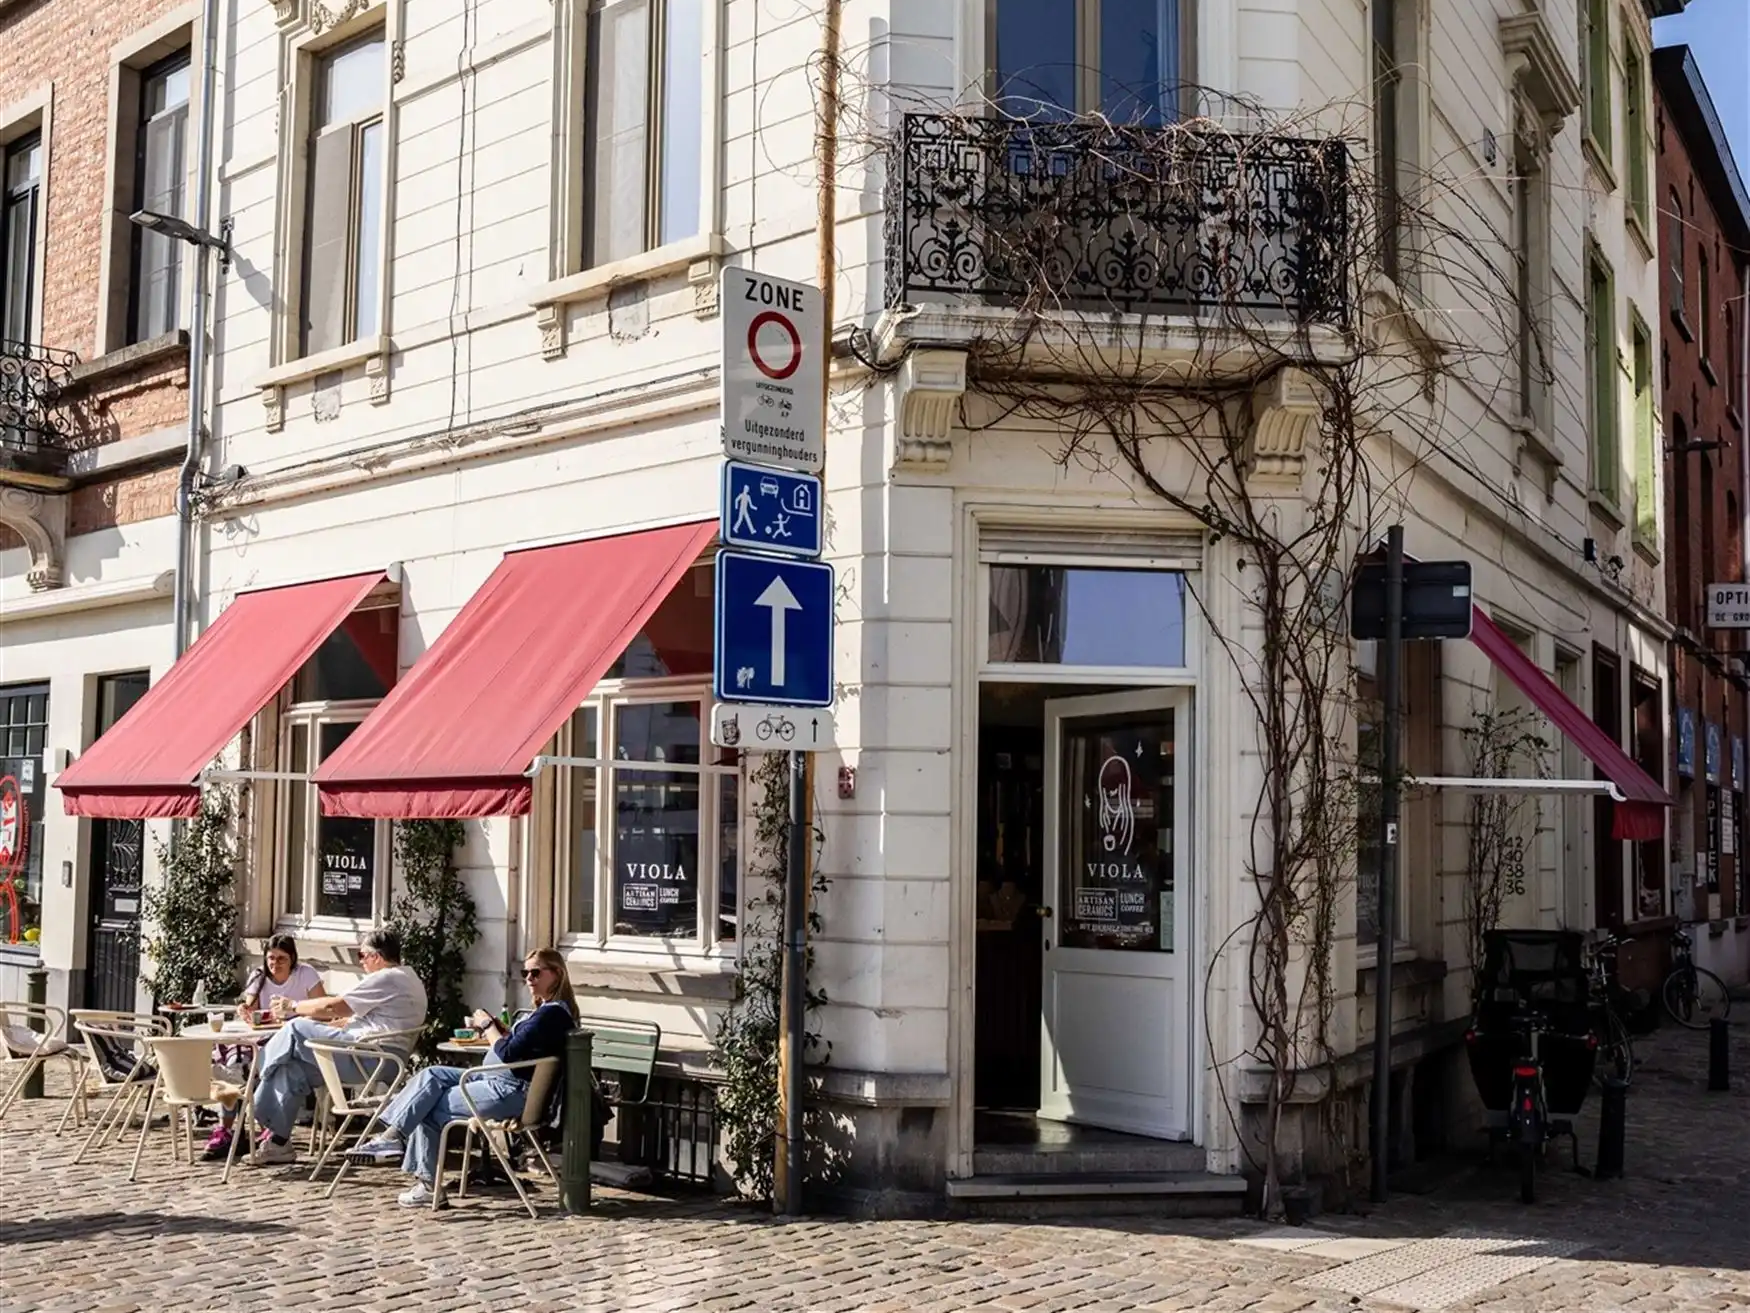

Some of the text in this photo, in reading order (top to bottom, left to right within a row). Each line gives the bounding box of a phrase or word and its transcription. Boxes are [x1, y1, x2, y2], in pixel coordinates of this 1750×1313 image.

[745, 278, 804, 312] ZONE
[745, 419, 805, 442] Uitgezonderd
[731, 439, 818, 463] vergunninghouders
[1716, 591, 1749, 605] OPTI
[1505, 836, 1523, 848] 42
[1707, 791, 1717, 883] PTIEK
[326, 854, 367, 870] VIOLA
[1505, 850, 1523, 863] 40
[626, 863, 687, 881] VIOLA
[1087, 863, 1144, 879] VIOLA
[1506, 863, 1525, 878] 38
[1506, 879, 1526, 896] 36
[1078, 895, 1115, 905] ARTISAN
[1120, 892, 1145, 904] LUNCH
[1079, 904, 1114, 917] CERAMICS
[1120, 905, 1145, 913] COFFEE
